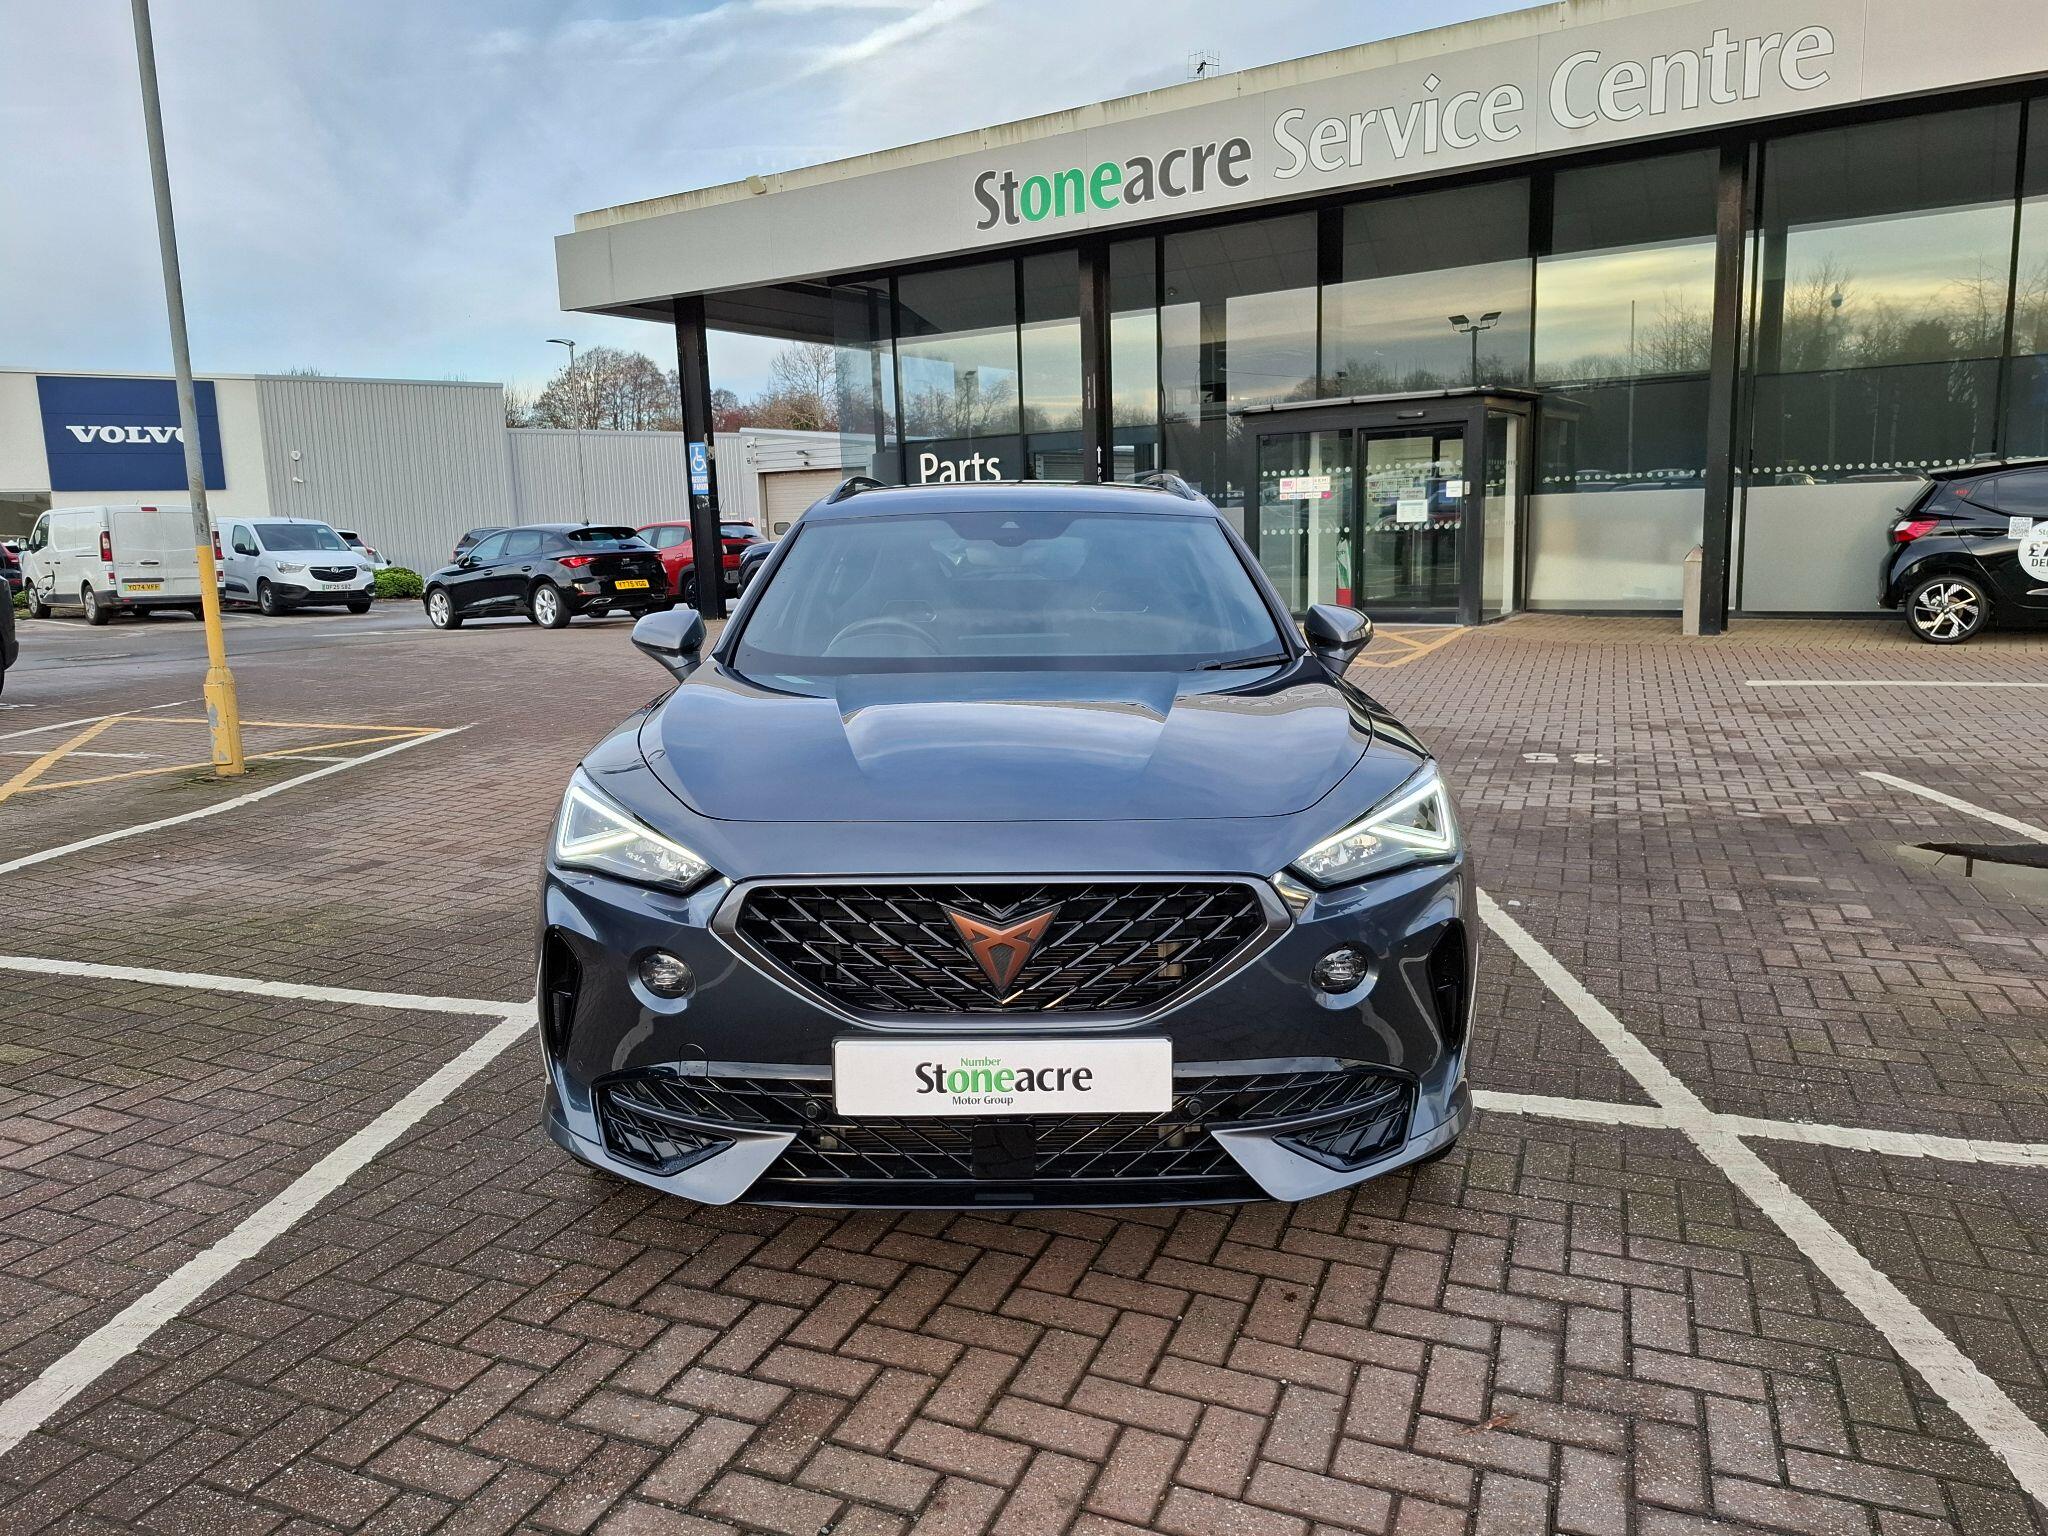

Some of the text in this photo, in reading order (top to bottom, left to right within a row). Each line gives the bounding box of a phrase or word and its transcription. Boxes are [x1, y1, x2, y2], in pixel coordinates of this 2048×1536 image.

[973, 25, 1835, 231] Stoneacre Service Centre
[66, 425, 184, 444] VOLV
[920, 452, 1001, 484] Parts
[960, 1056, 1001, 1067] Number
[915, 1062, 1093, 1094] Stoneacre
[952, 1096, 1014, 1106] Motor Group
